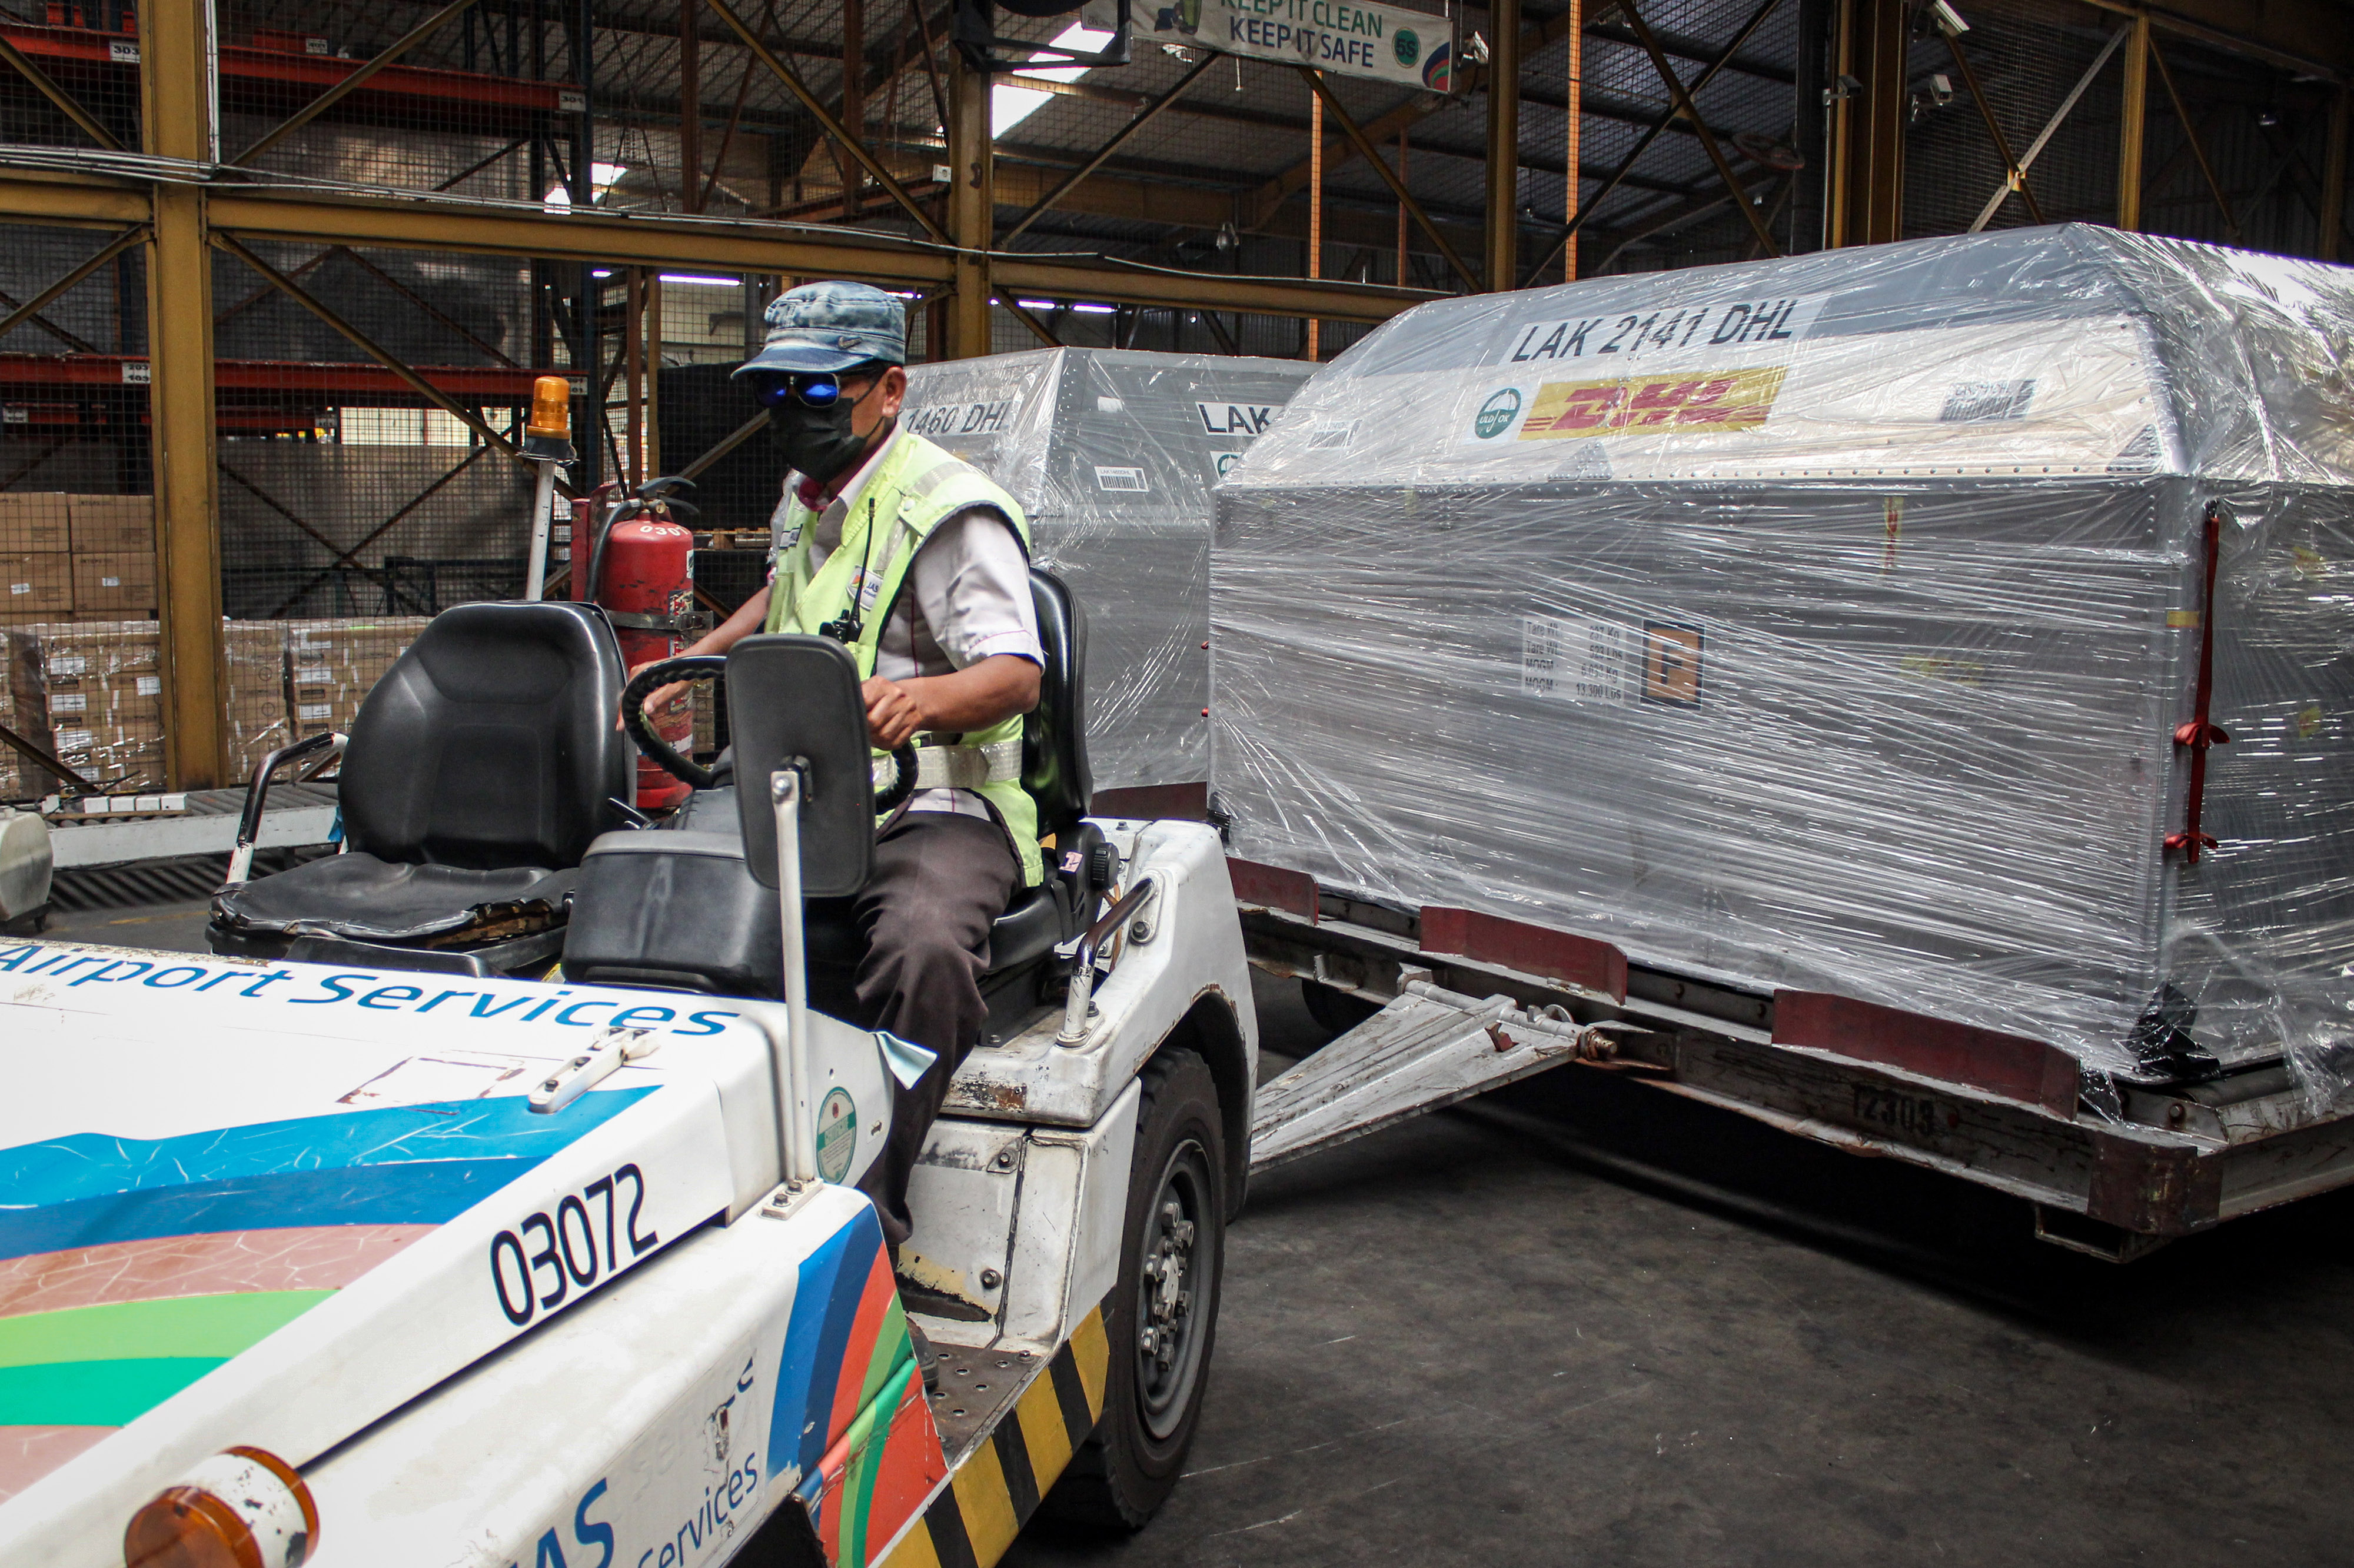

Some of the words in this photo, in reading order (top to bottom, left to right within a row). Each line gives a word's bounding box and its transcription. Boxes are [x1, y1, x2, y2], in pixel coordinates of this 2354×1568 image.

[1313, 1, 1382, 38] CLEAN
[114, 46, 139, 55] 303
[1230, 16, 1291, 48] KEEP
[1296, 28, 1315, 54] IT
[1321, 34, 1374, 68] SAFE
[1395, 39, 1417, 56] 5S
[1511, 318, 1604, 363] LAK
[1597, 307, 1710, 355] 2141
[1708, 299, 1798, 345] DHL
[1198, 404, 1271, 434] LAK
[1550, 378, 1739, 431] DHL
[907, 406, 959, 435] 1460
[1526, 640, 1544, 654] Tare
[1527, 621, 1544, 635] Tare
[1607, 627, 1620, 644] Kg
[1605, 665, 1618, 683] Kg
[0, 944, 295, 999] Airport
[286, 973, 742, 1036] Services
[490, 1163, 659, 1327] 03072
